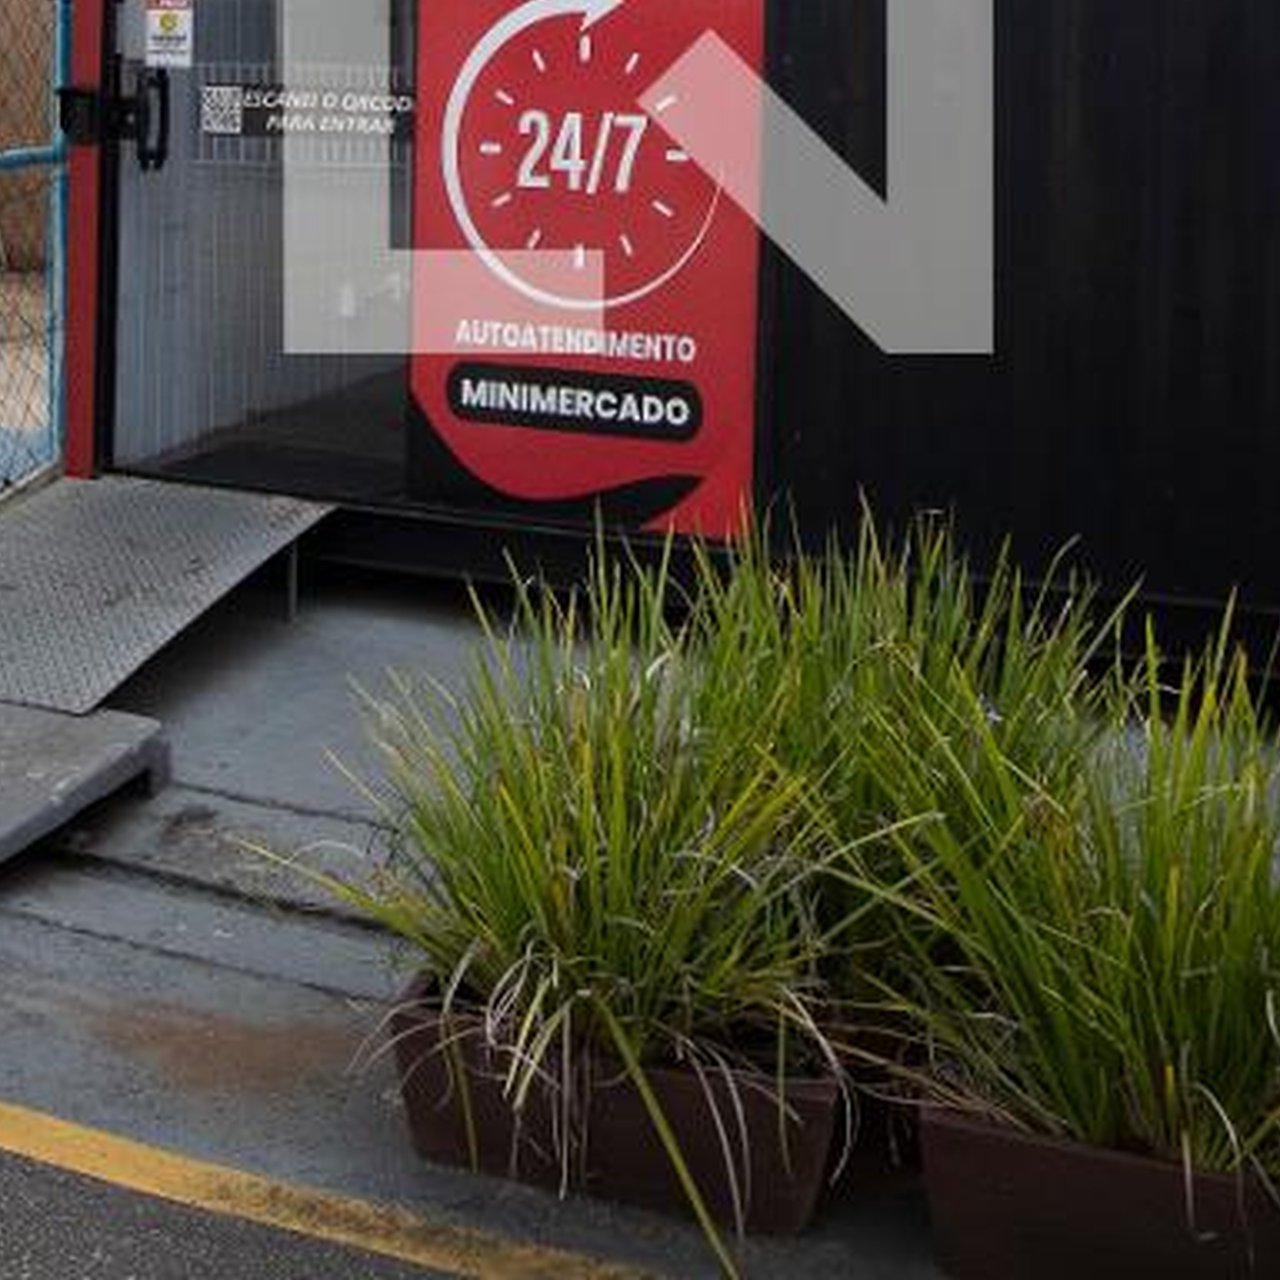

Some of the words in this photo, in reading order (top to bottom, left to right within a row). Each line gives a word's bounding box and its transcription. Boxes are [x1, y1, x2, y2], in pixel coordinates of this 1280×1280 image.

[517, 109, 649, 195] 24/7
[455, 319, 697, 362] AUTOATENDIMENTO
[460, 378, 691, 426] MINIMERCADO
